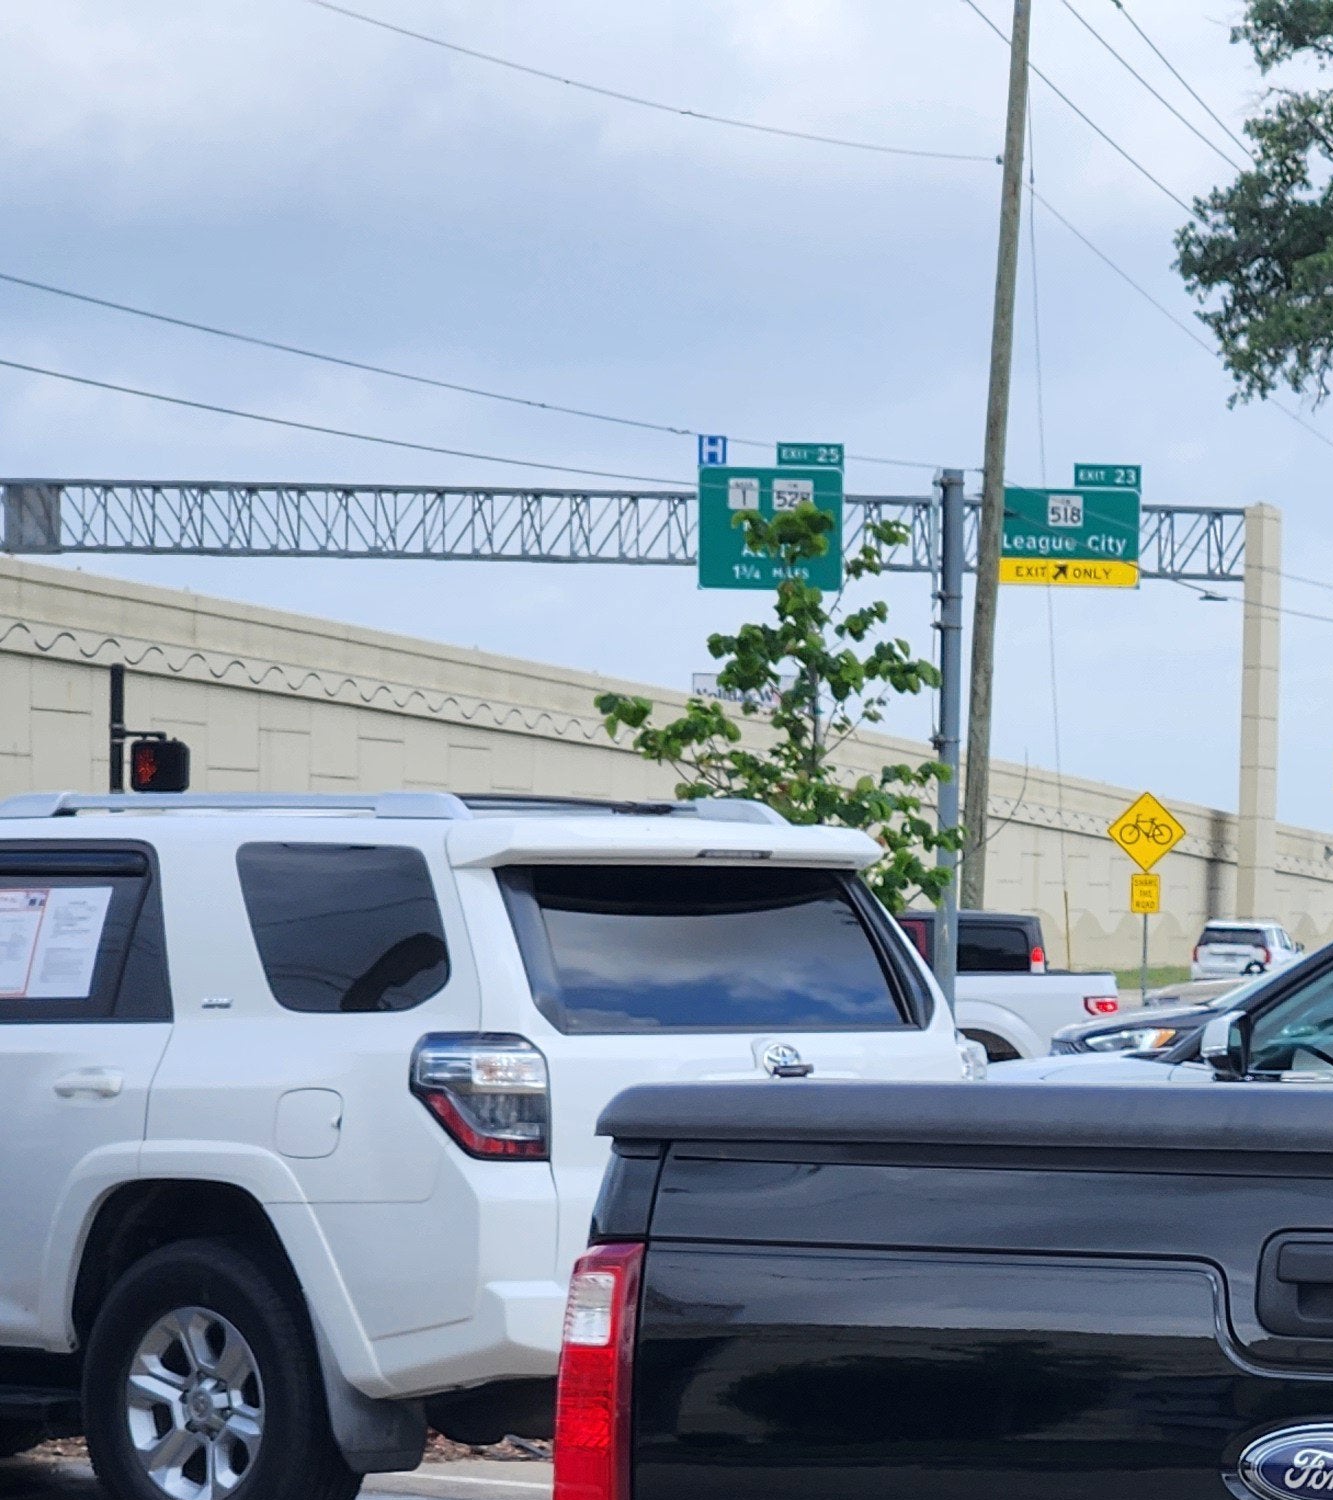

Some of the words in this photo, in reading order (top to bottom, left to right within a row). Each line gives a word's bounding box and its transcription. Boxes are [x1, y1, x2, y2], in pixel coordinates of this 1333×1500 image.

[781, 449, 807, 459] EXIT
[817, 447, 839, 462] 25
[1079, 470, 1105, 481] EXIT
[1114, 469, 1136, 484] 23
[1050, 506, 1082, 523] 518
[1003, 534, 1077, 555] League
[1088, 534, 1127, 555] City
[1015, 566, 1047, 577] EXIT
[1073, 568, 1112, 579] ONLY
